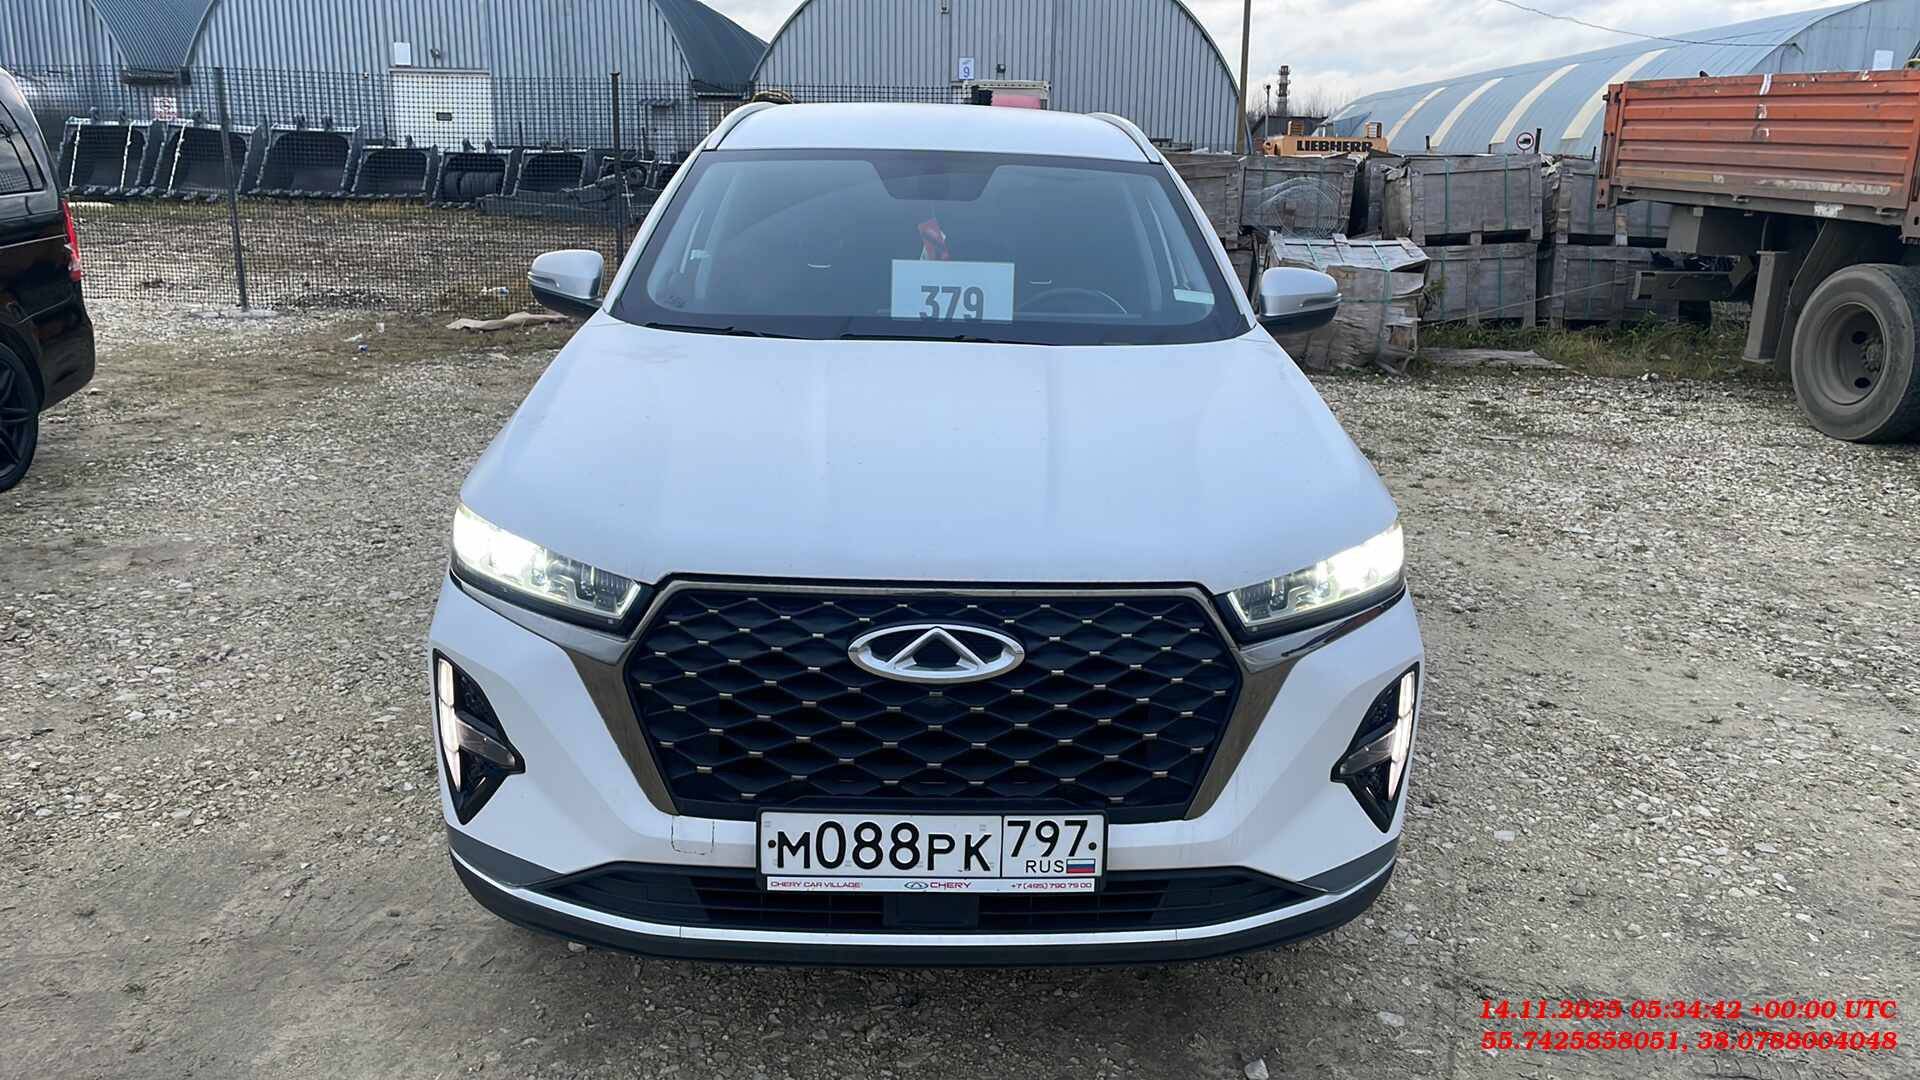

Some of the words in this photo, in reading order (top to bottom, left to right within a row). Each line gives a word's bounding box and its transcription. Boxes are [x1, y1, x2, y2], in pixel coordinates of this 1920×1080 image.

[963, 66, 970, 78] 9
[1296, 140, 1373, 153] LIEBHERR
[919, 285, 984, 320] 379
[1007, 820, 1088, 857] 797
[1025, 860, 1064, 873] RUS
[930, 881, 972, 889] CHERY
